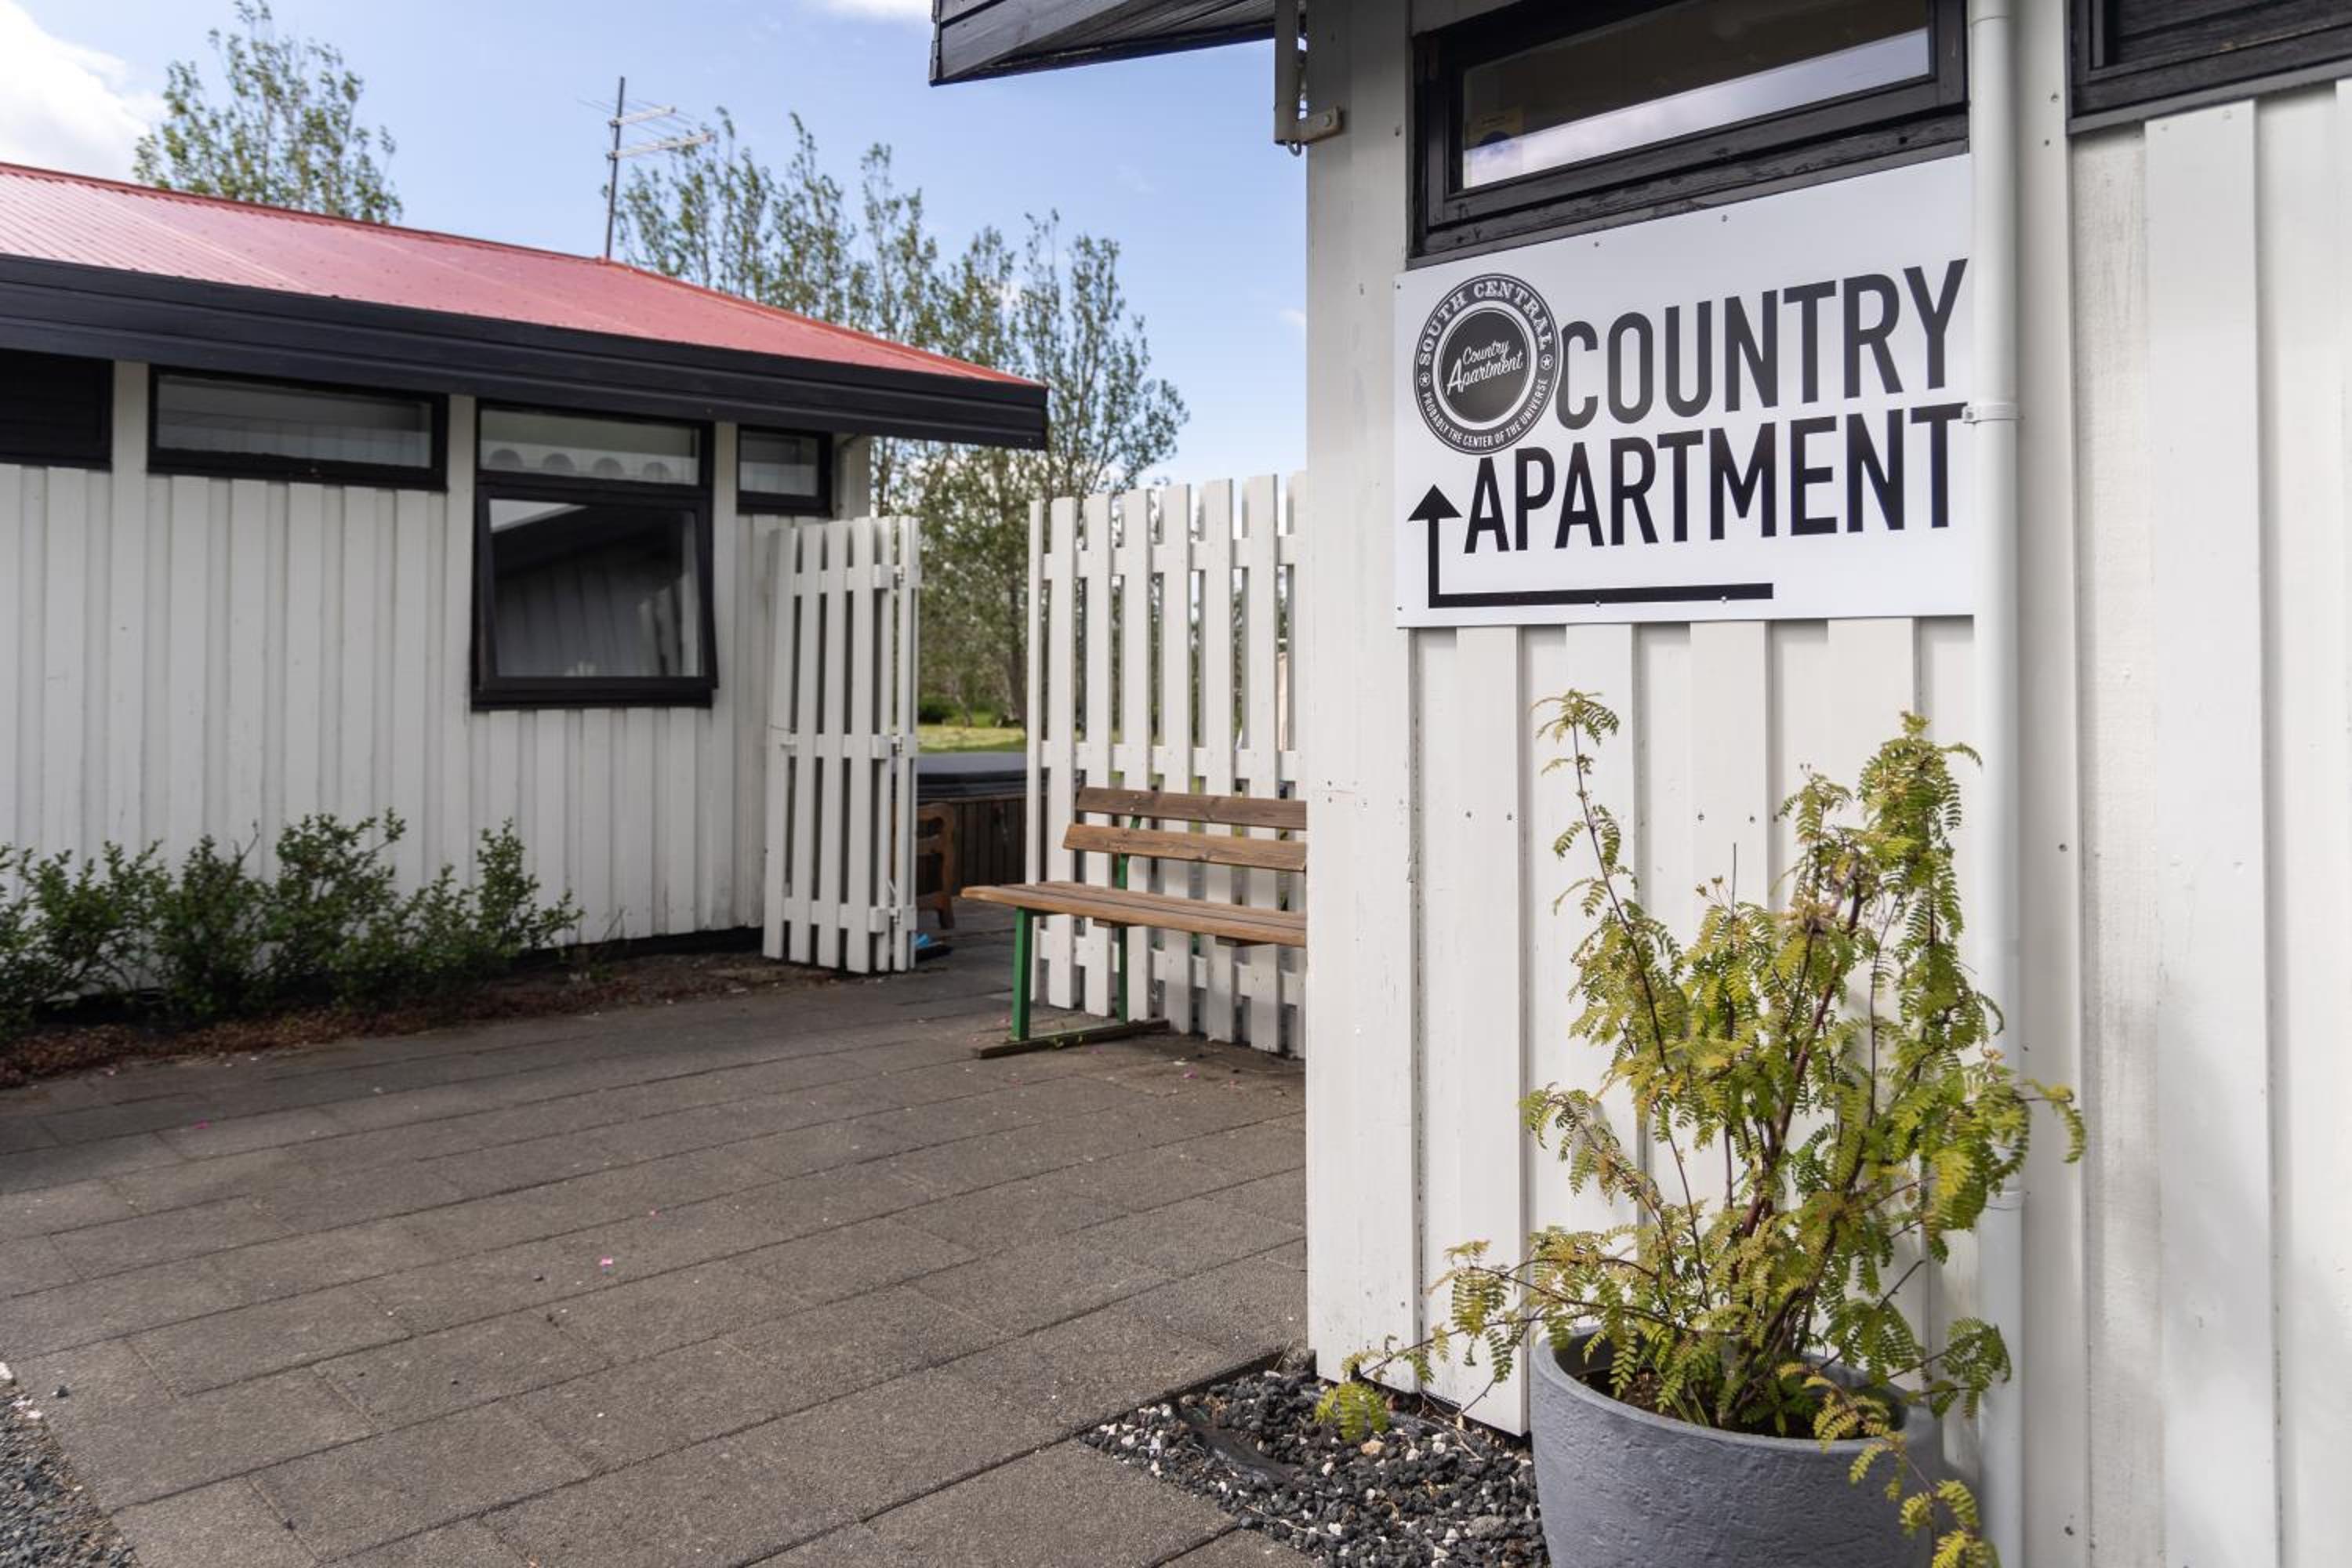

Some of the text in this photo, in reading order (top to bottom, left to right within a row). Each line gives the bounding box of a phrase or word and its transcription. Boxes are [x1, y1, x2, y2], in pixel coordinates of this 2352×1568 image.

[1419, 281, 1552, 365] SOUTH CENTRAL
[1463, 340, 1510, 365] Country
[1556, 258, 1968, 430] COUNTRY
[1446, 350, 1523, 396] Apartment
[1423, 379, 1548, 447] PROBABLY THE CENTER OF THE UNIVERSE
[1464, 402, 1969, 554] APARTMENT
